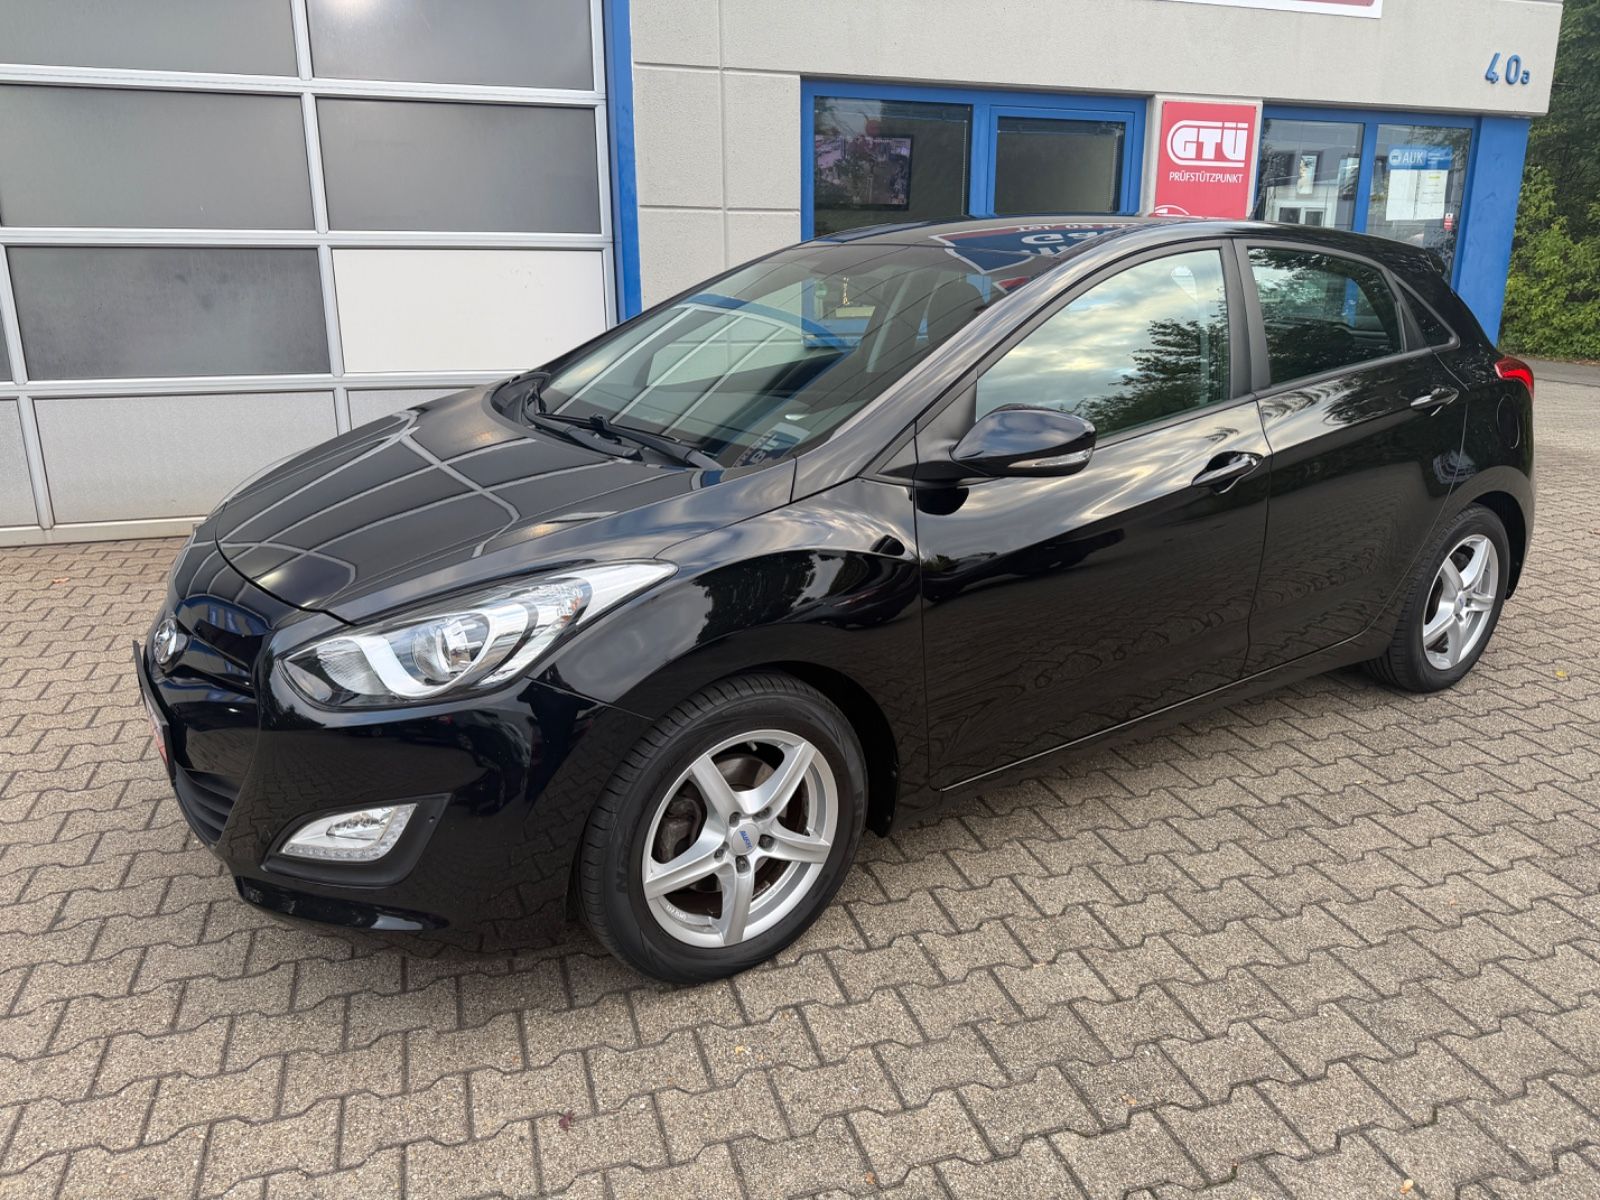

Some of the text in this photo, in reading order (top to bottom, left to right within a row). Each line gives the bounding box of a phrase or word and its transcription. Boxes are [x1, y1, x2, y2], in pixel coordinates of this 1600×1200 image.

[1484, 52, 1530, 85] 40a
[1169, 121, 1248, 162] GTÜ
[1402, 151, 1425, 164] AUK
[1169, 169, 1243, 183] PRÜFSTÜTZPUNKT
